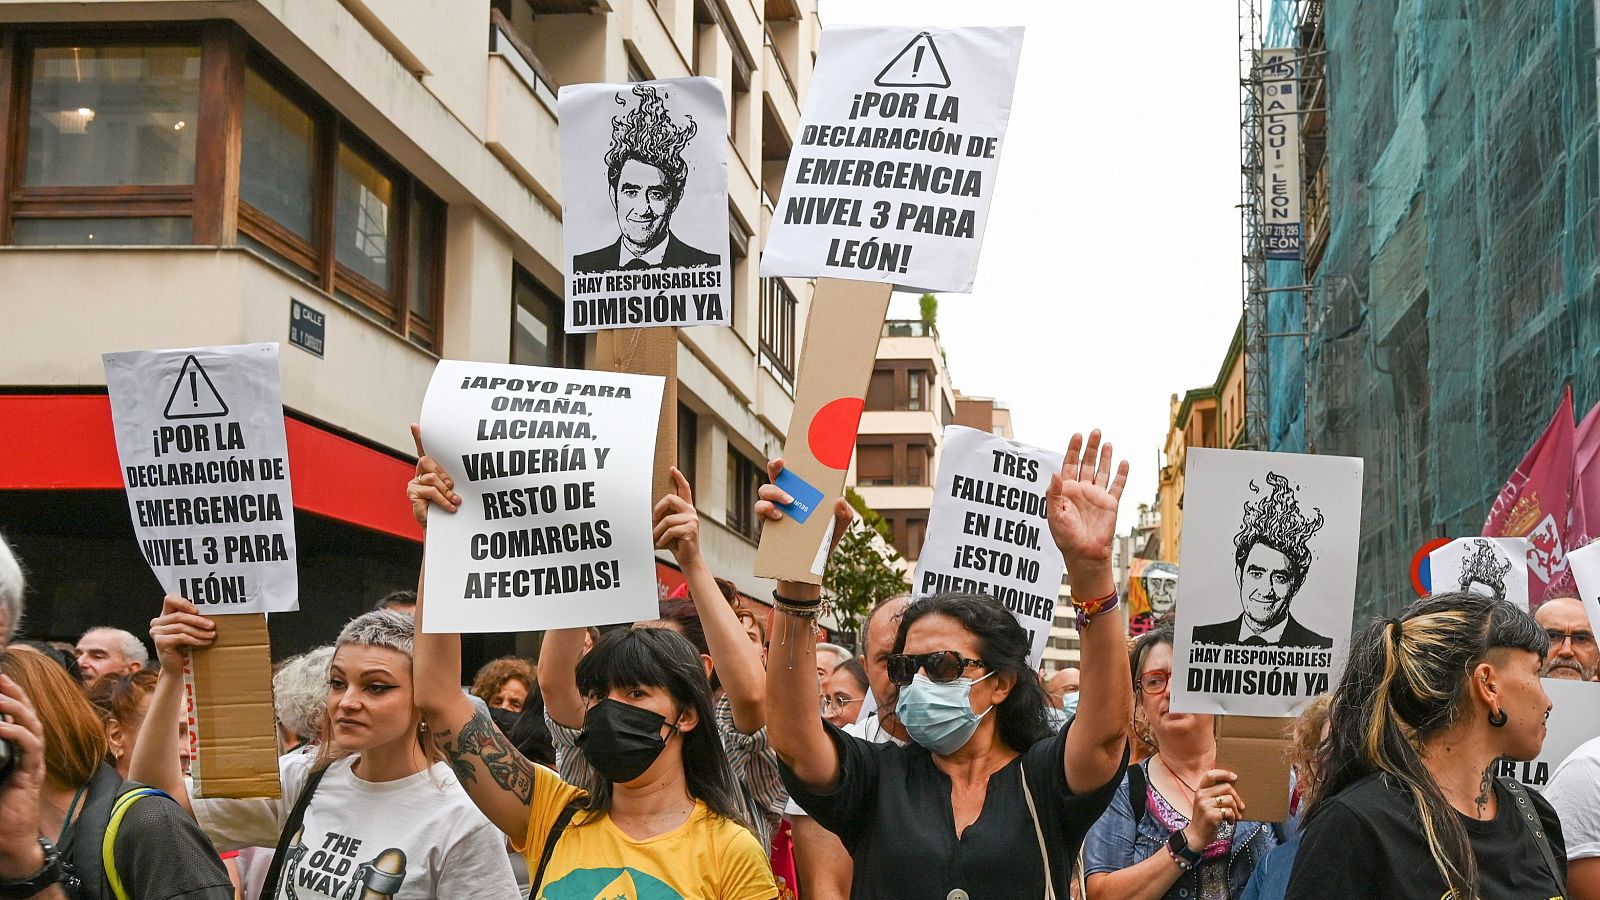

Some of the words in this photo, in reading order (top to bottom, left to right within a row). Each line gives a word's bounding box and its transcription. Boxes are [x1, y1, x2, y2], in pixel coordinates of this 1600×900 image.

[849, 91, 920, 120] ¡POR
[924, 93, 959, 124] LA
[801, 125, 963, 155] DECLARACIÓN
[966, 136, 998, 159] DE
[795, 157, 982, 198] EMERGENCIA
[783, 197, 863, 228] NIVEL
[869, 200, 891, 230] 3
[896, 202, 976, 239] PARA
[825, 237, 913, 274] LEÓN!
[572, 275, 603, 297] ¡HAY
[606, 271, 721, 292] RESPONSABLES!
[303, 308, 322, 327] CALLE
[572, 291, 687, 327] DIMISIÓN
[692, 293, 723, 321] YA
[460, 376, 558, 394] ¡APOYO
[564, 383, 632, 399] PARA
[490, 396, 593, 417] OMAÑA,
[153, 424, 210, 457] ¡POR
[215, 422, 245, 450] LA
[476, 419, 598, 441] LACIANA,
[126, 456, 255, 488] DECLARACIÓN
[259, 458, 284, 480] DE
[461, 444, 587, 482] VALDERÍA
[594, 447, 611, 469] Y
[992, 449, 1039, 483] TRES
[136, 493, 283, 527] EMERGENCIA
[481, 485, 557, 521] RESTO
[563, 481, 596, 511] DE
[793, 499, 808, 512] SEUR
[951, 474, 1048, 520] FALLECIDO
[470, 519, 612, 561] COMARCAS
[963, 511, 990, 538] EN
[993, 519, 1041, 551] LEÓN.
[143, 538, 198, 566] NIVEL
[203, 537, 219, 565] 3
[224, 533, 288, 563] PARA
[953, 544, 1013, 577] ¡ESTO
[1016, 557, 1040, 584] NO
[179, 572, 246, 604] LEÓN!
[464, 559, 621, 599] AFECTADAS!
[993, 585, 1054, 622] VOLVER
[1189, 648, 1221, 664] ¡HAY
[1223, 649, 1331, 668] RESPONSABLES!
[1186, 667, 1299, 697] DIMISIÓN
[1304, 672, 1329, 697] YA
[1522, 761, 1549, 786] LA
[321, 832, 362, 858] THE
[309, 850, 352, 877] OLD
[299, 867, 347, 898] WAY
